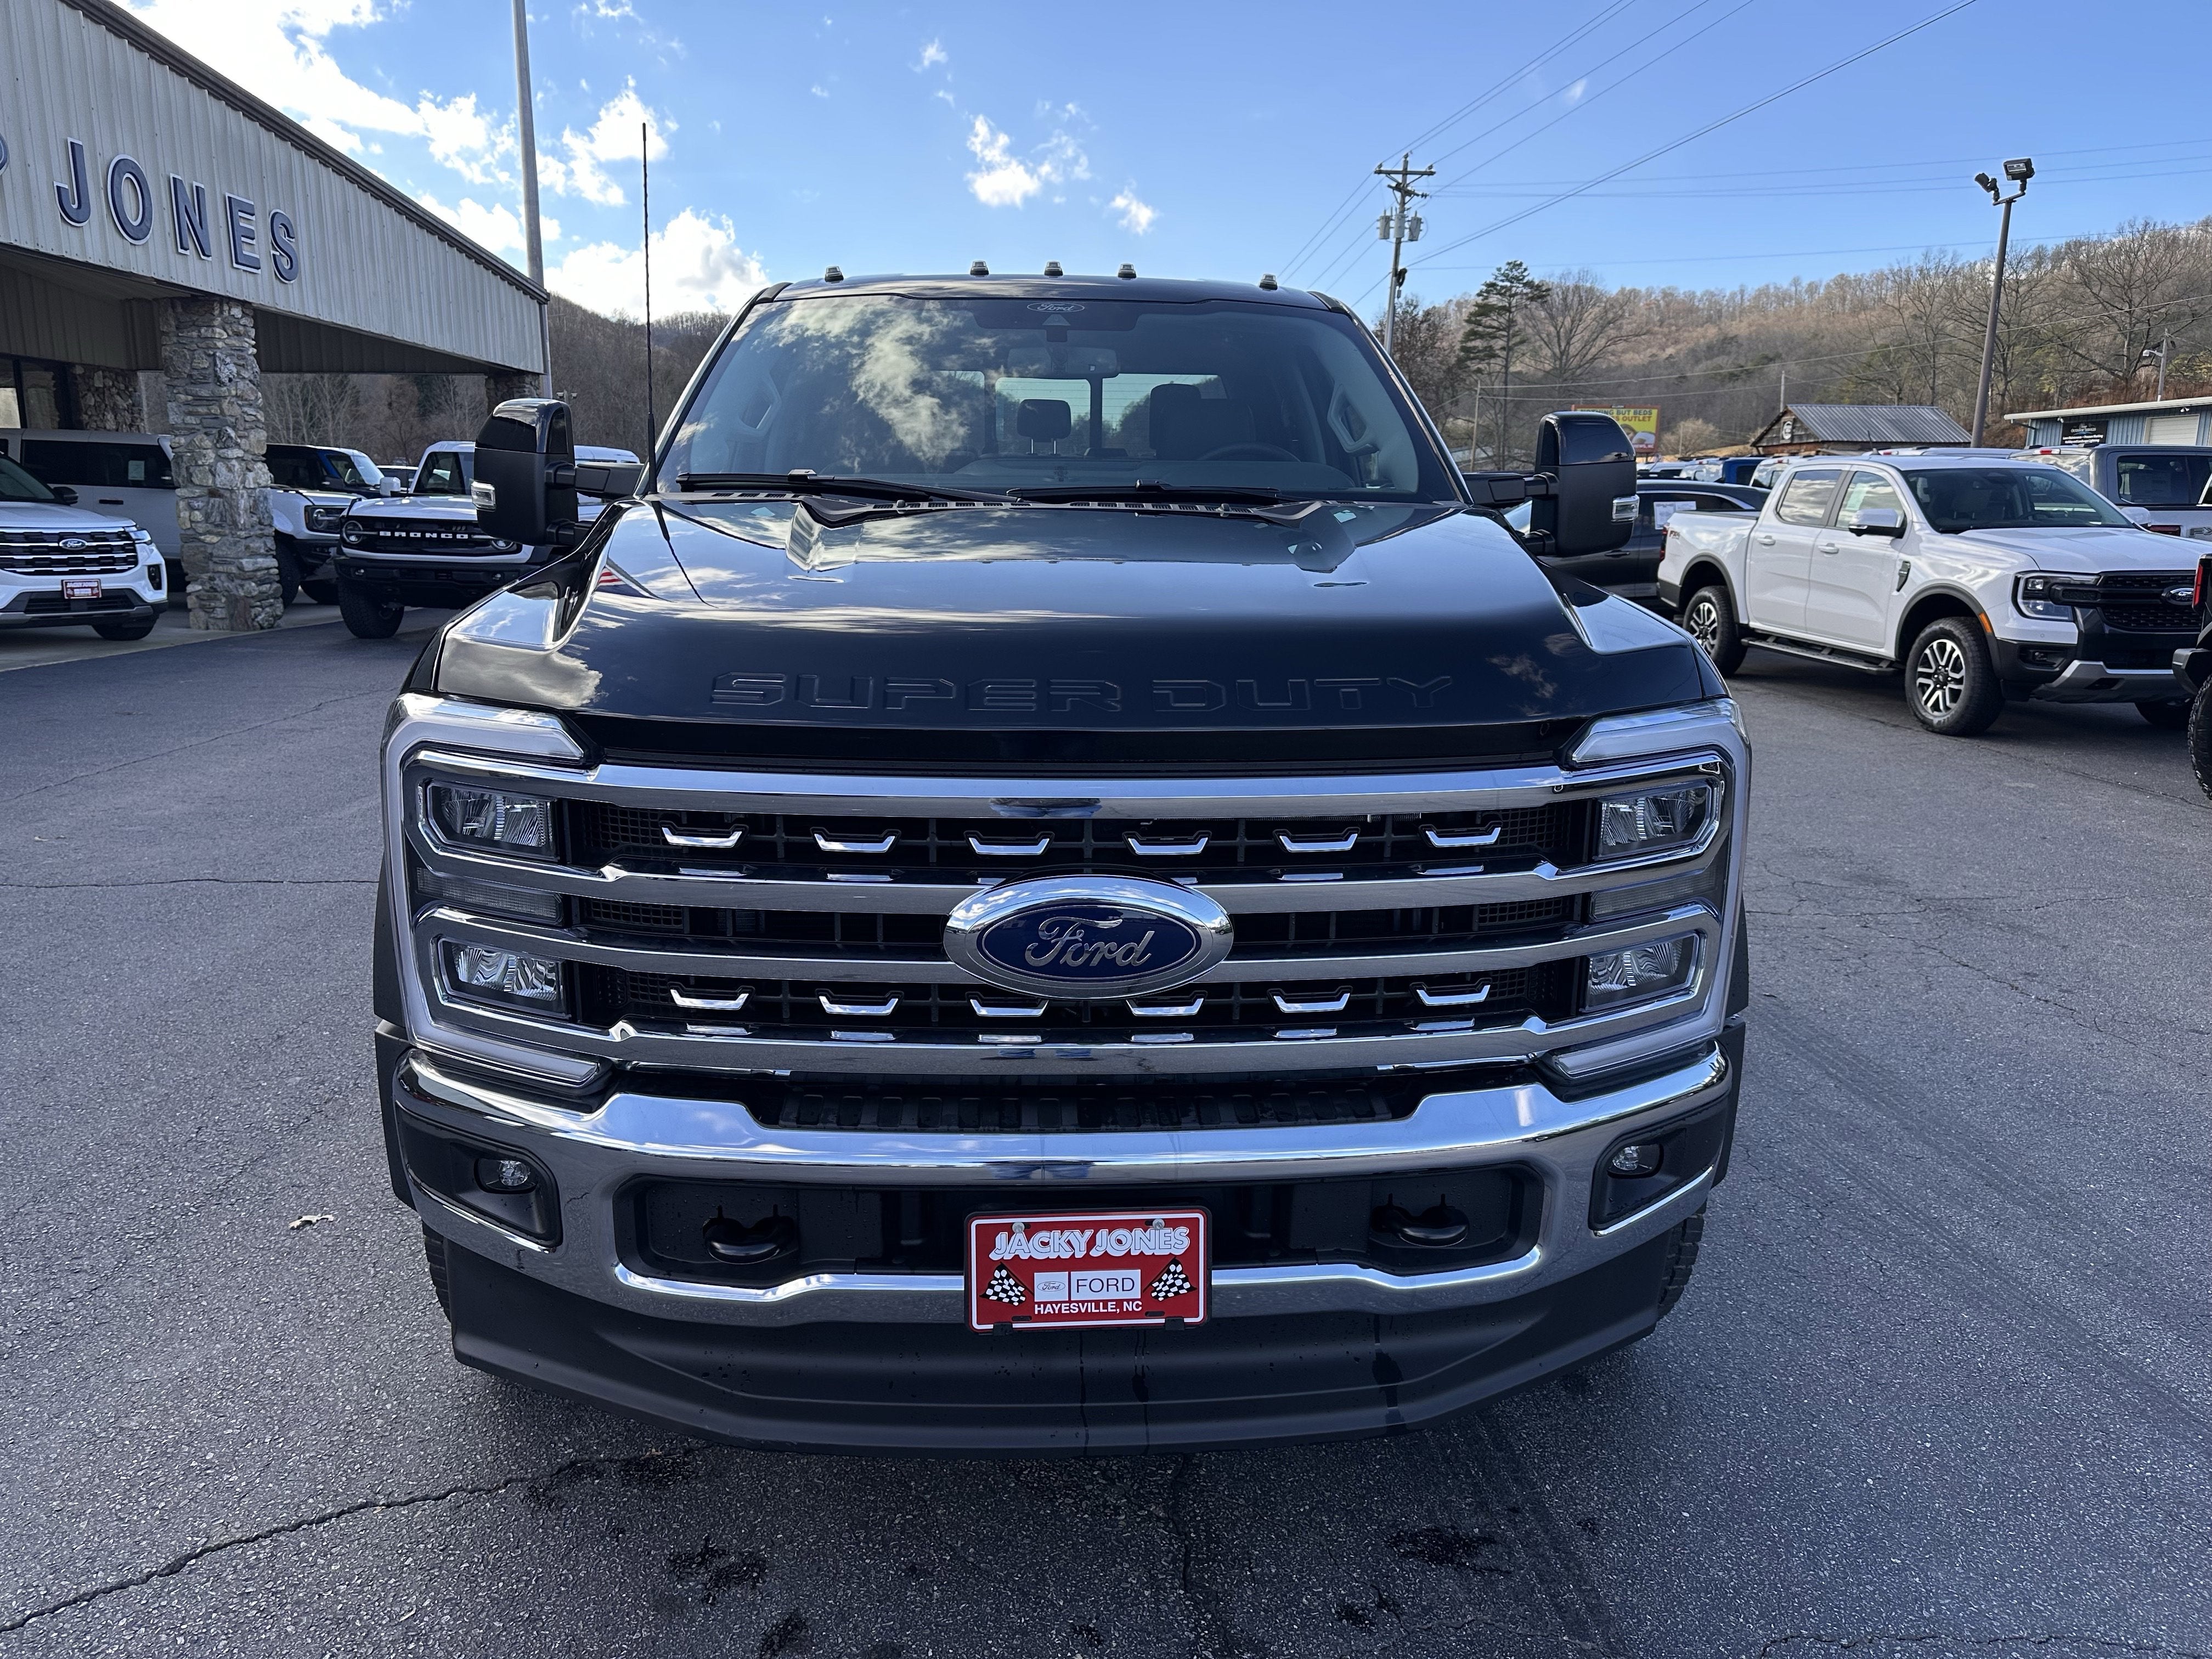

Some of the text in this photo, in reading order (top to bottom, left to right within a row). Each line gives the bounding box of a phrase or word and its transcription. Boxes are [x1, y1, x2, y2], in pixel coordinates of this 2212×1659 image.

[54, 137, 300, 284] JONES
[1037, 303, 1075, 311] Ford
[379, 531, 469, 539] BRONCO
[711, 672, 1453, 712] SUPER DUTY
[1024, 917, 1155, 967] Ford
[989, 1226, 1190, 1261] JACKY JONES
[1042, 1277, 1135, 1293] Ford FORD
[1034, 1301, 1142, 1314] HAYESVILLE, NC
